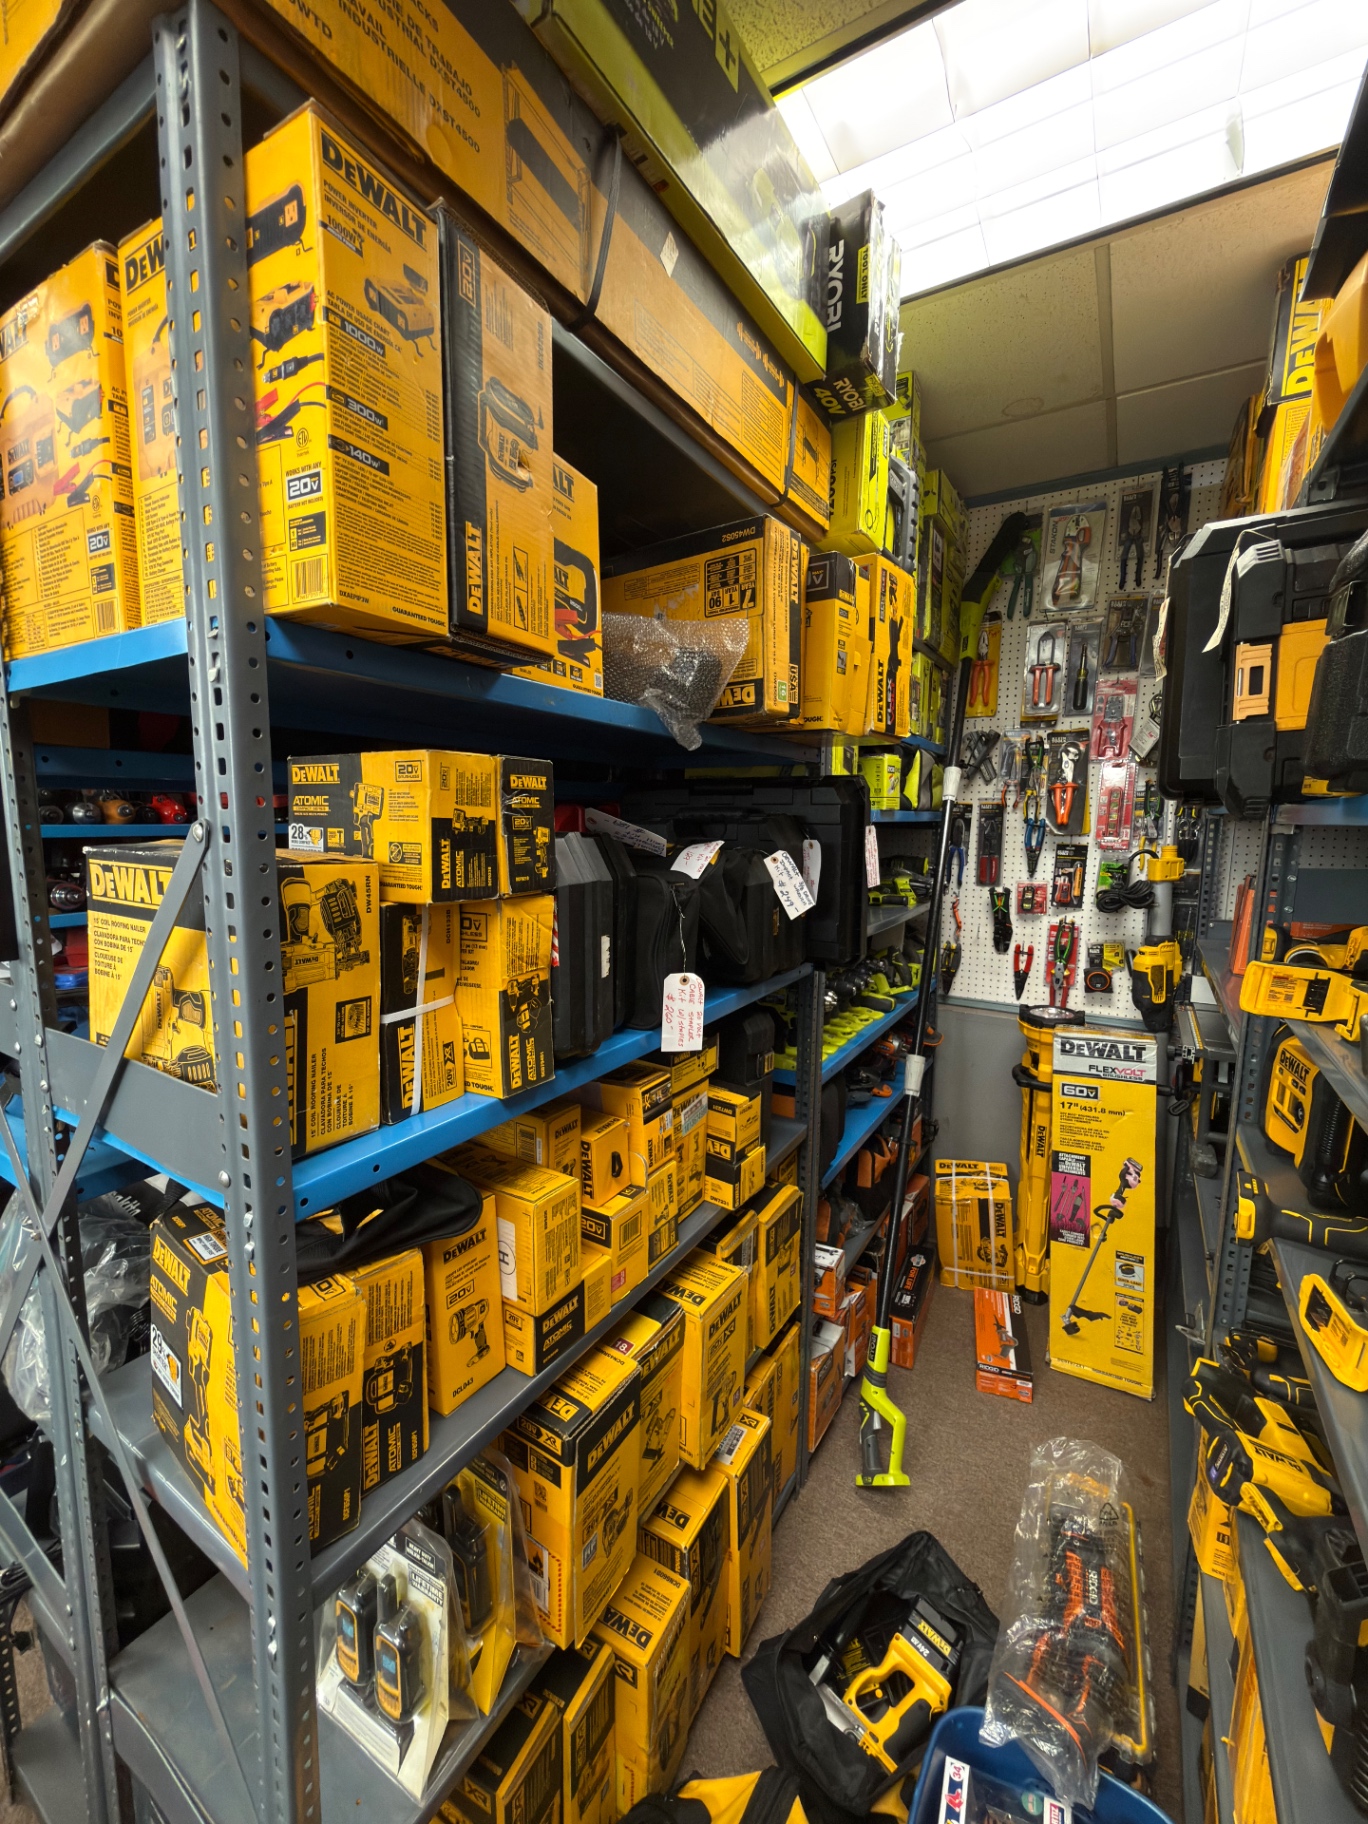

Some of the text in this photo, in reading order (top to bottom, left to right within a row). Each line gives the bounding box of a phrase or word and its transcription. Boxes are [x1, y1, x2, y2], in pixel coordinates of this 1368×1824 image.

[425, 35, 472, 96] TRABAJO
[429, 92, 480, 153] DXST4500
[321, 131, 428, 246] DEWALT
[827, 239, 844, 334] RYOBI
[860, 274, 868, 300] ONLY
[813, 386, 847, 417] 40V
[833, 377, 867, 413] RYOBI
[721, 526, 756, 543] DW450S2
[466, 521, 483, 614] DEWALT
[791, 538, 801, 605] DEWALT
[708, 597, 722, 610] 90
[724, 585, 739, 604] 1 YEAR
[740, 583, 755, 610] 7 YEAR
[391, 606, 428, 622] GUARANTEED
[789, 665, 797, 692] USA
[877, 659, 885, 723] DEWALT
[292, 766, 340, 782] DEWALT
[511, 776, 547, 789] DEWALT
[293, 796, 329, 806] ATOMIC
[441, 838, 451, 889] DEWALT
[89, 863, 173, 906] DEWALT
[94, 930, 130, 944] CLAVADORA PARA
[100, 919, 146, 933] COIL ROOFING NAILER
[94, 952, 123, 964] CLOUEUSE DE
[104, 941, 119, 949] BOBINA
[94, 960, 112, 969] TOITURE
[94, 968, 110, 978] BOBINE
[509, 1033, 522, 1090] DEWALT
[526, 1037, 534, 1080] ATOMIC
[1060, 1039, 1147, 1062] DEWALT
[401, 1024, 415, 1108] DEWALT
[1088, 1064, 1147, 1077] FLEXVOLT
[1102, 1073, 1143, 1081] BRUSHLESS
[1280, 1049, 1310, 1083] DEWALT
[1063, 1085, 1096, 1098] 60V
[1079, 1104, 1106, 1114] (431.8
[1108, 1109, 1126, 1117] mm)
[555, 1119, 578, 1140] DEWALT
[1034, 1125, 1046, 1158] DEWALT
[581, 1141, 595, 1200] DEWALT
[939, 1162, 978, 1170] DEWALT
[995, 1202, 1006, 1239] DEWALT
[443, 1229, 487, 1265] DEWALT
[153, 1237, 191, 1292] DEWALT
[150, 1274, 179, 1314] ATOMIC
[449, 1285, 473, 1304] 20V
[542, 1296, 578, 1335] DEWALT
[709, 1289, 742, 1341] DEWALT
[542, 1320, 573, 1352] ATOMIC
[616, 1339, 628, 1350] 18
[979, 1363, 1000, 1373] RIDGID
[452, 1377, 474, 1398] DCL043
[521, 1418, 558, 1447] 20V XR
[587, 1403, 635, 1474] DEWALT
[364, 1422, 379, 1491] DEWALT
[388, 1421, 397, 1473] ATOMIC
[1254, 1446, 1304, 1473] DEWALT
[411, 1572, 443, 1599] LIFETIME
[603, 1606, 653, 1651] DEWA
[916, 1619, 951, 1657] DEWALT
[952, 1765, 963, 1780] 34
